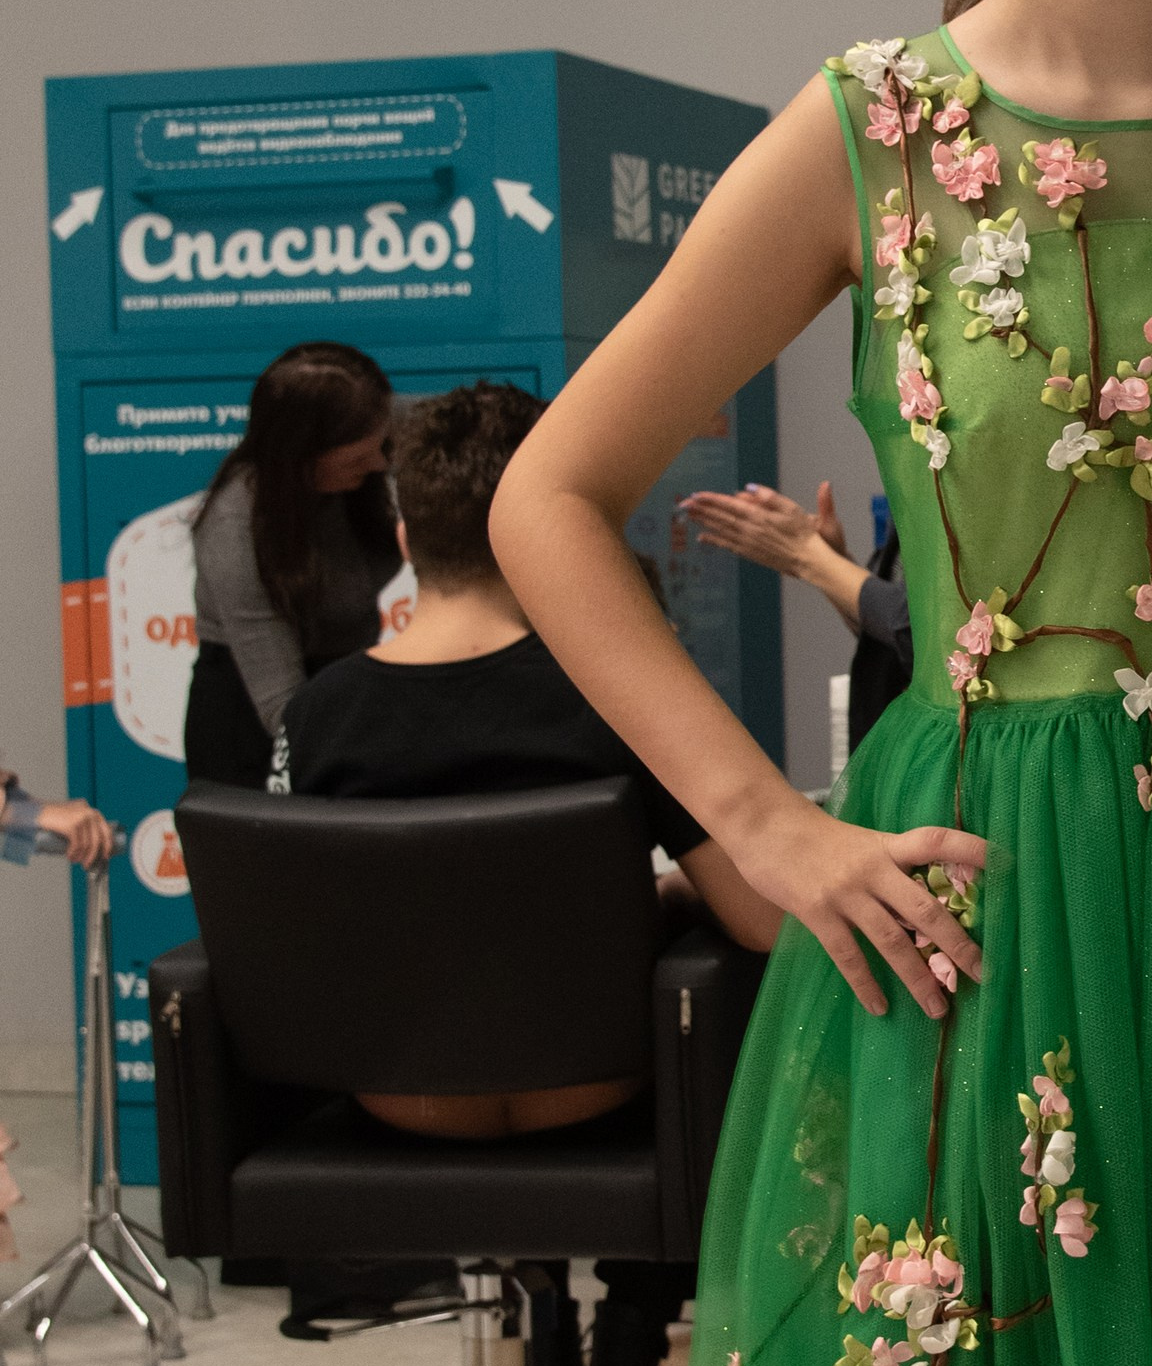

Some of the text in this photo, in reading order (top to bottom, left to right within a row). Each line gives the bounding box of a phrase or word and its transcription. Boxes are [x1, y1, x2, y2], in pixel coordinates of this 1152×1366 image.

[120, 196, 475, 283] Спасибо!
[117, 404, 210, 428] Примите
[84, 433, 244, 456] благотворител
